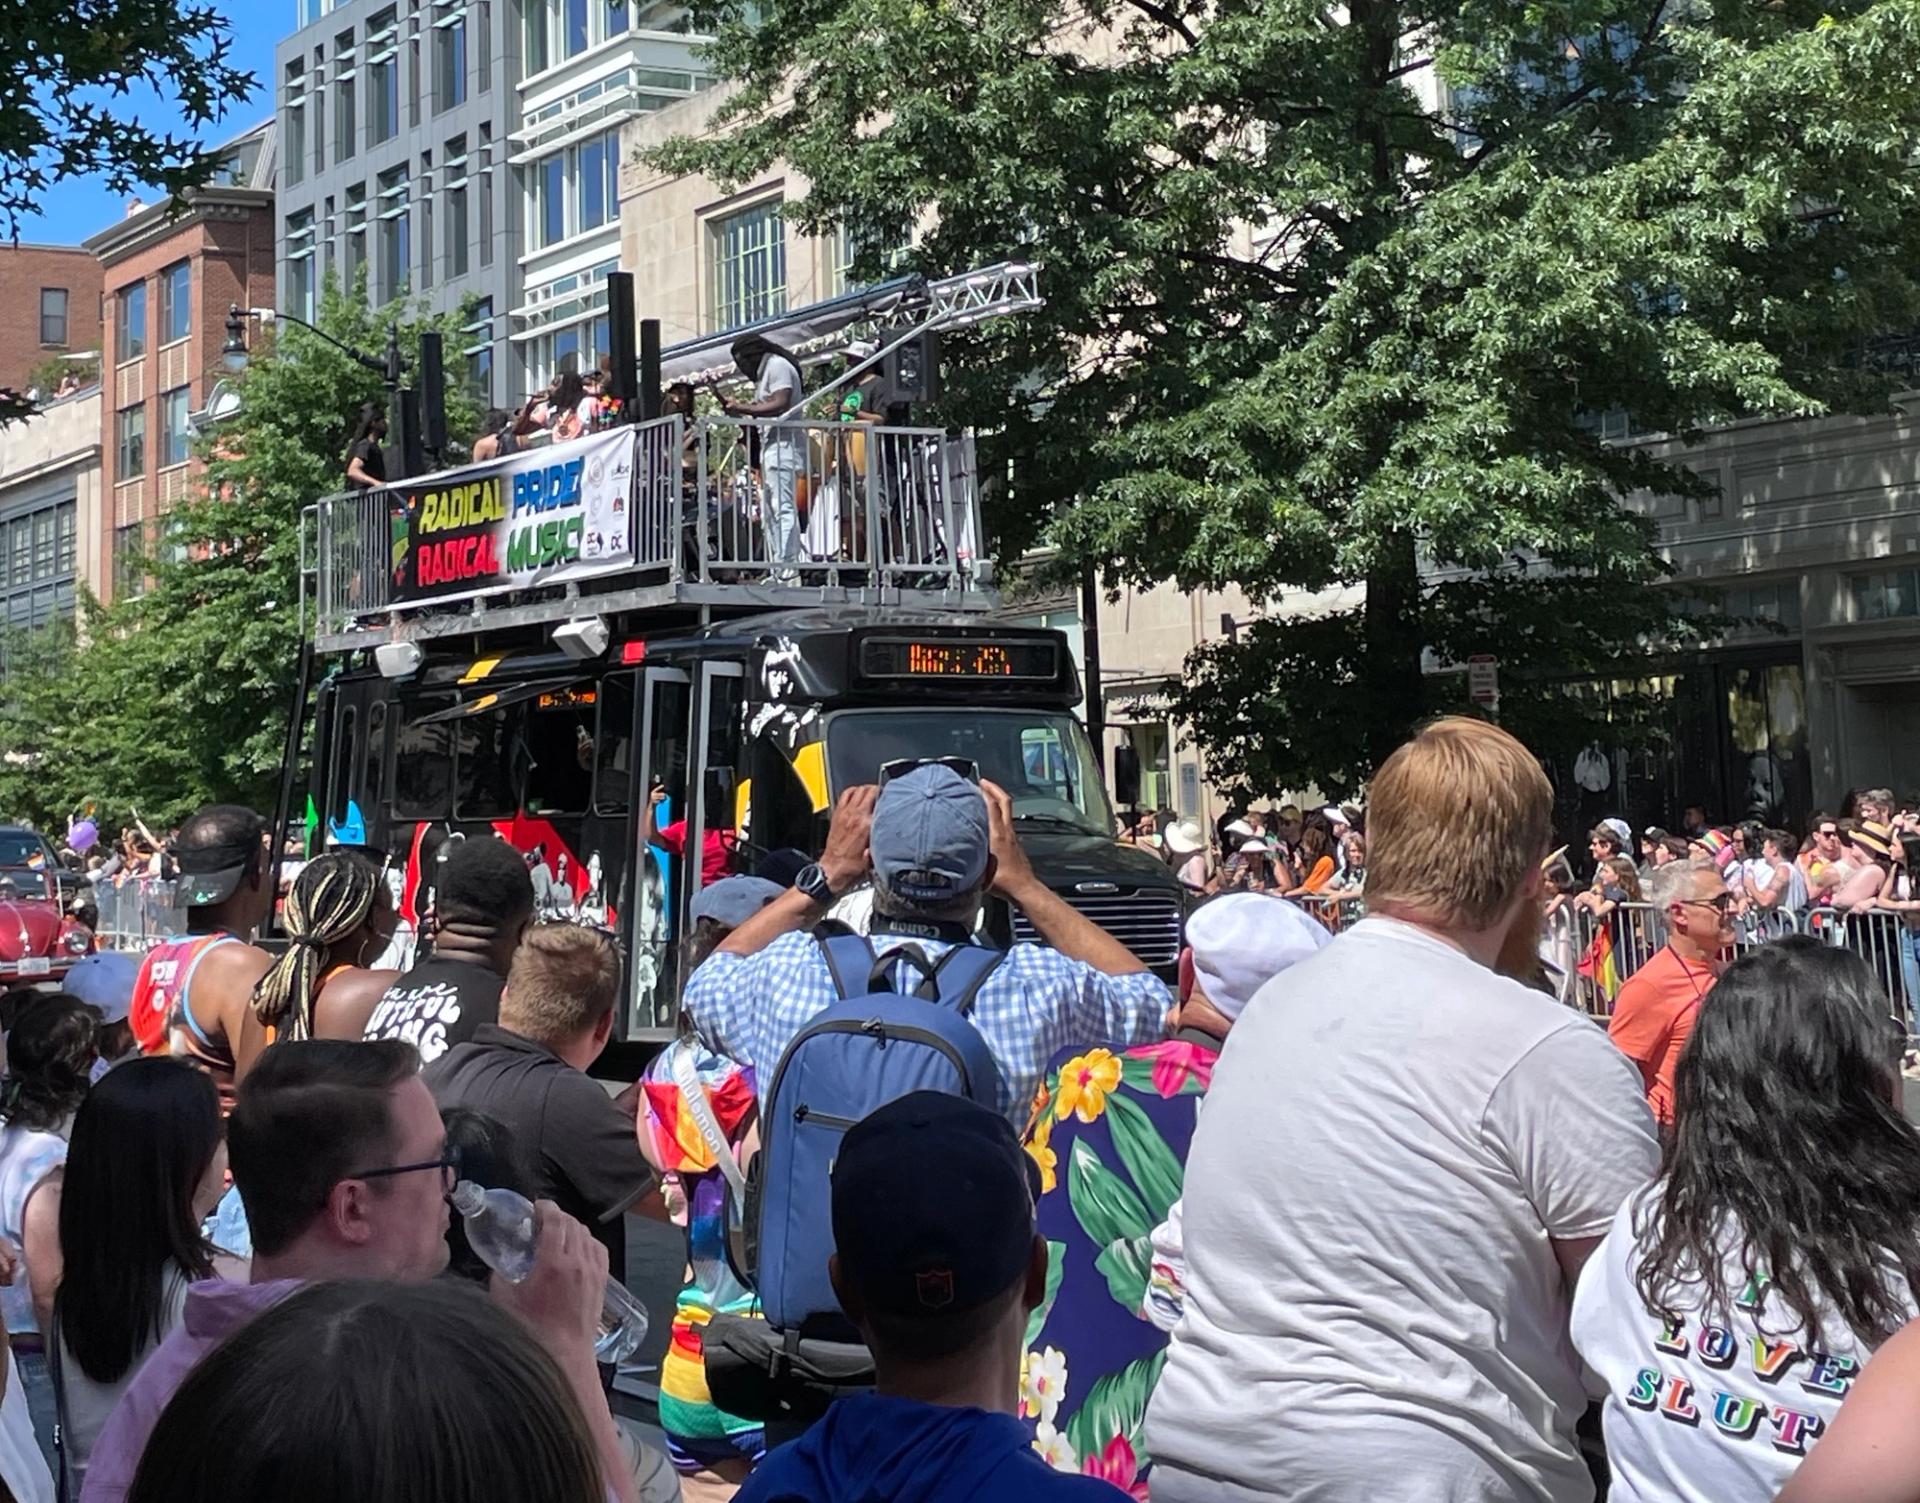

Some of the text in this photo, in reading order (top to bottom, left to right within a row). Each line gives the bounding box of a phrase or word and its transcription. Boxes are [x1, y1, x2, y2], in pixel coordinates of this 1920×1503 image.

[418, 477, 506, 535] RADICAL
[417, 533, 499, 587] RADICAL
[889, 921, 940, 938] Canon
[1654, 1312, 1860, 1402] LOVE
